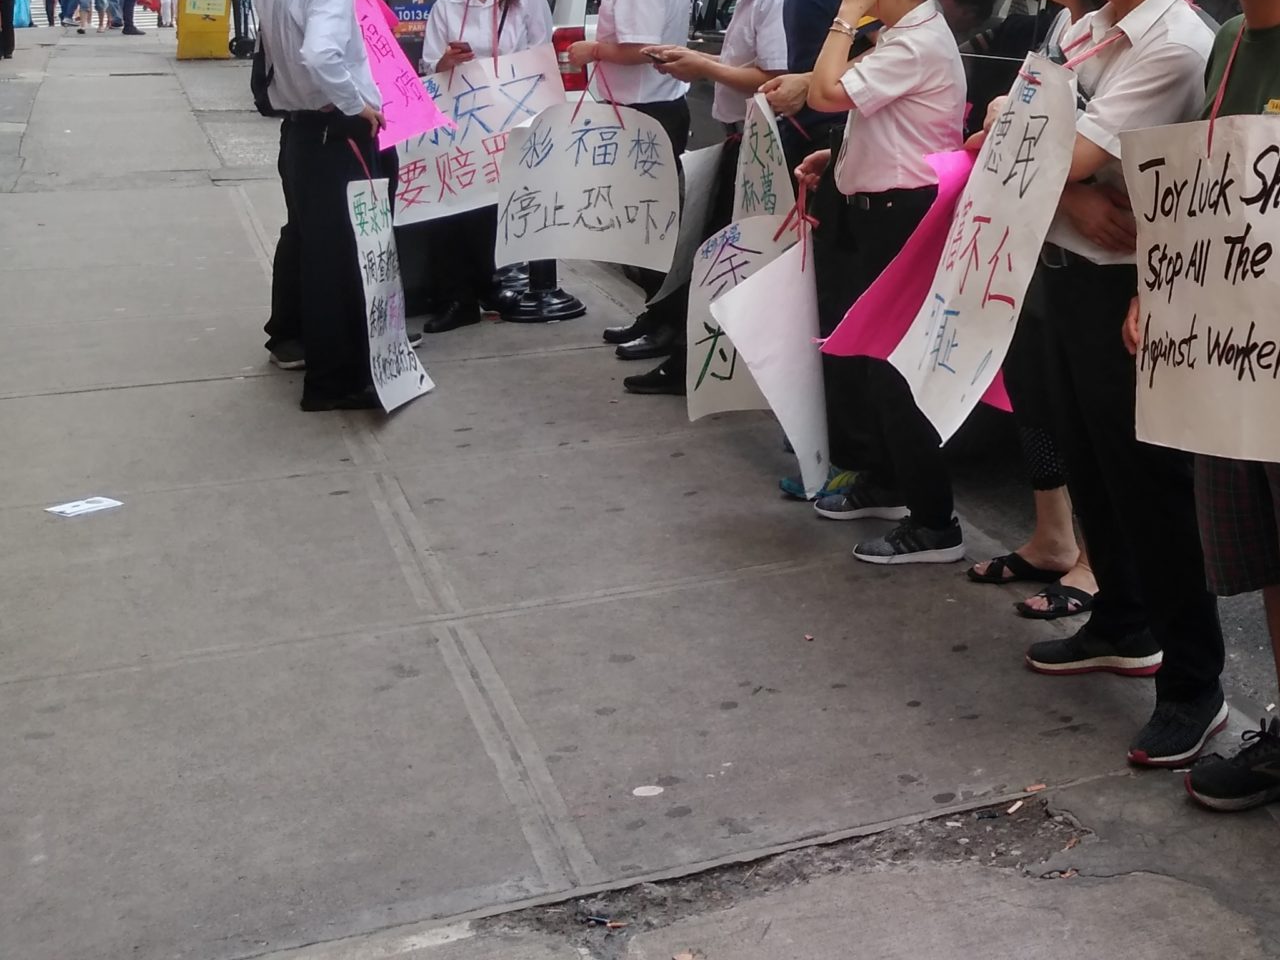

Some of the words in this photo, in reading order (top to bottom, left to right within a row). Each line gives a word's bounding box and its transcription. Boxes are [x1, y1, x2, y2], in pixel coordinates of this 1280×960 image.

[398, 10, 430, 21] 10136
[1224, 222, 1272, 284] The
[1140, 313, 1198, 389] Against
